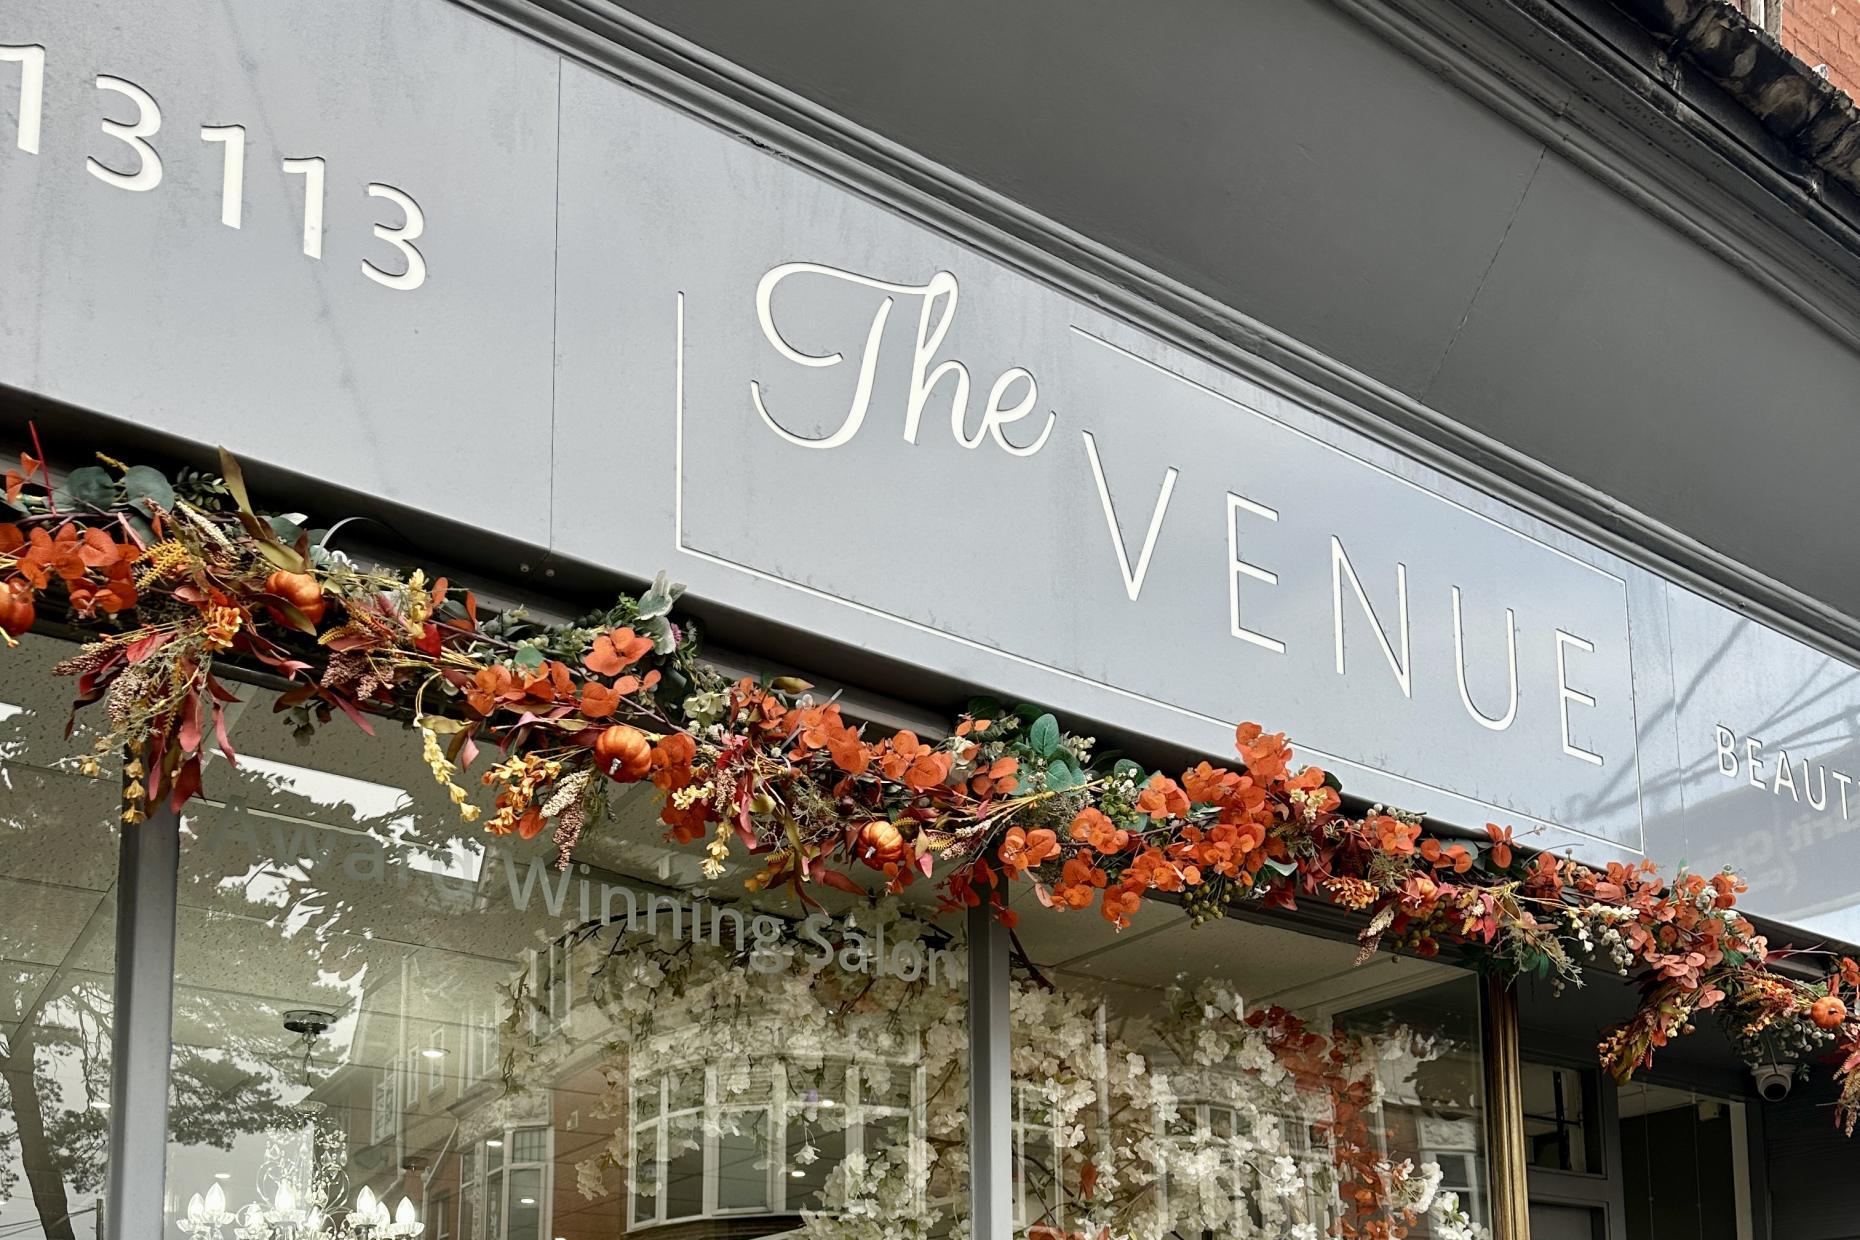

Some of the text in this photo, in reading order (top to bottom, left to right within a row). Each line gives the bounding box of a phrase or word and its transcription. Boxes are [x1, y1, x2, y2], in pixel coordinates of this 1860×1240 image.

[751, 261, 1056, 456] The
[1082, 430, 1603, 767] VENUE
[1716, 724, 1860, 820] BEAUT
[503, 853, 785, 974] Winning
[805, 913, 958, 989] Salon
